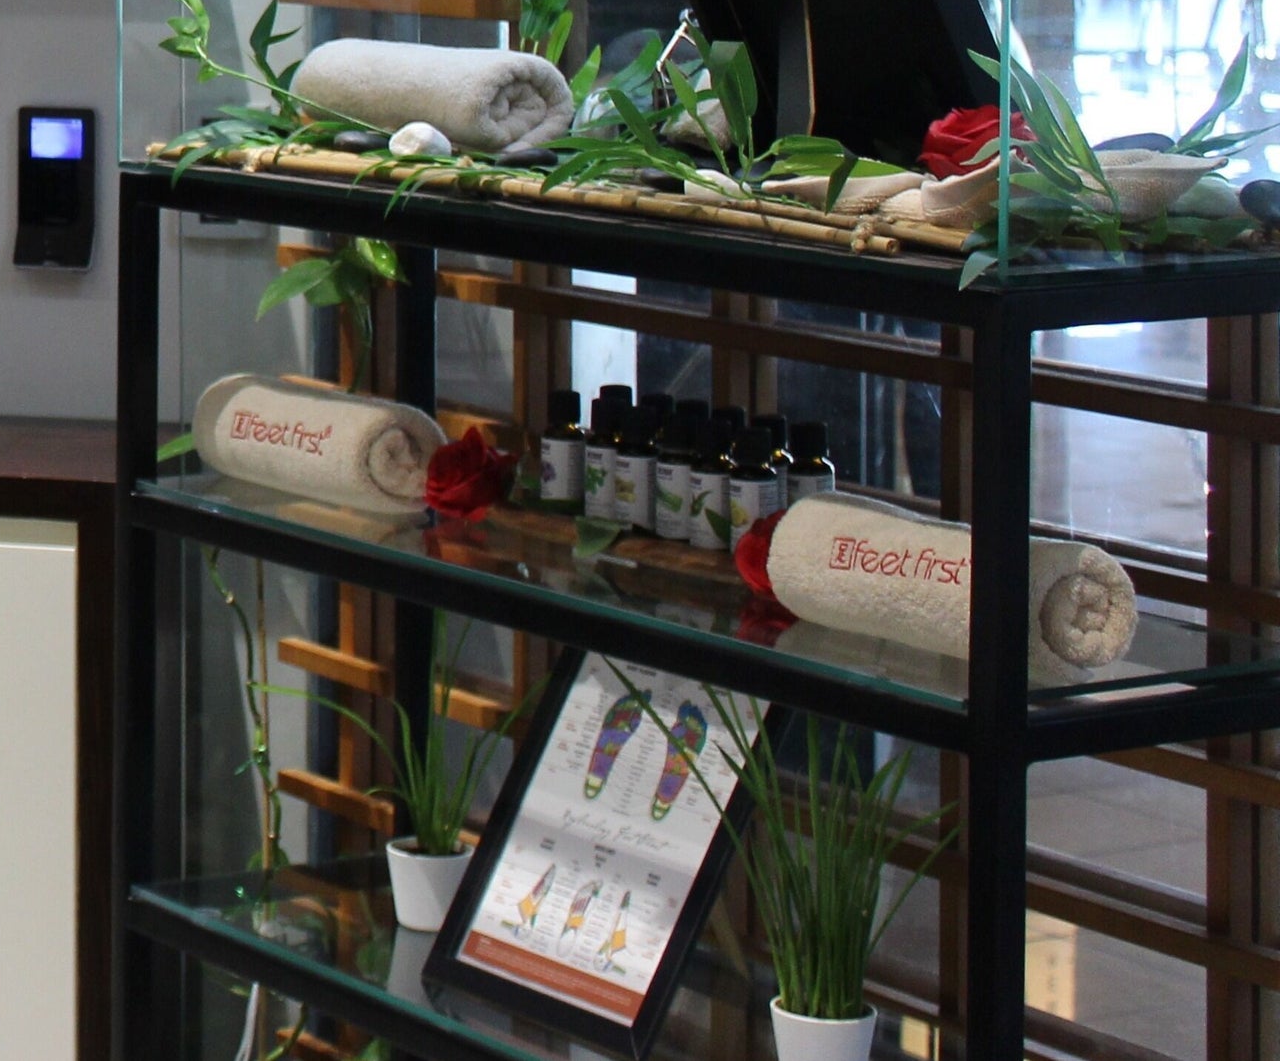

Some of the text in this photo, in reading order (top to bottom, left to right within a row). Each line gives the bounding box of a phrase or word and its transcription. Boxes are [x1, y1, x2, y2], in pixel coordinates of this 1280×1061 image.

[248, 413, 288, 447] feet
[852, 539, 967, 585] feet first
